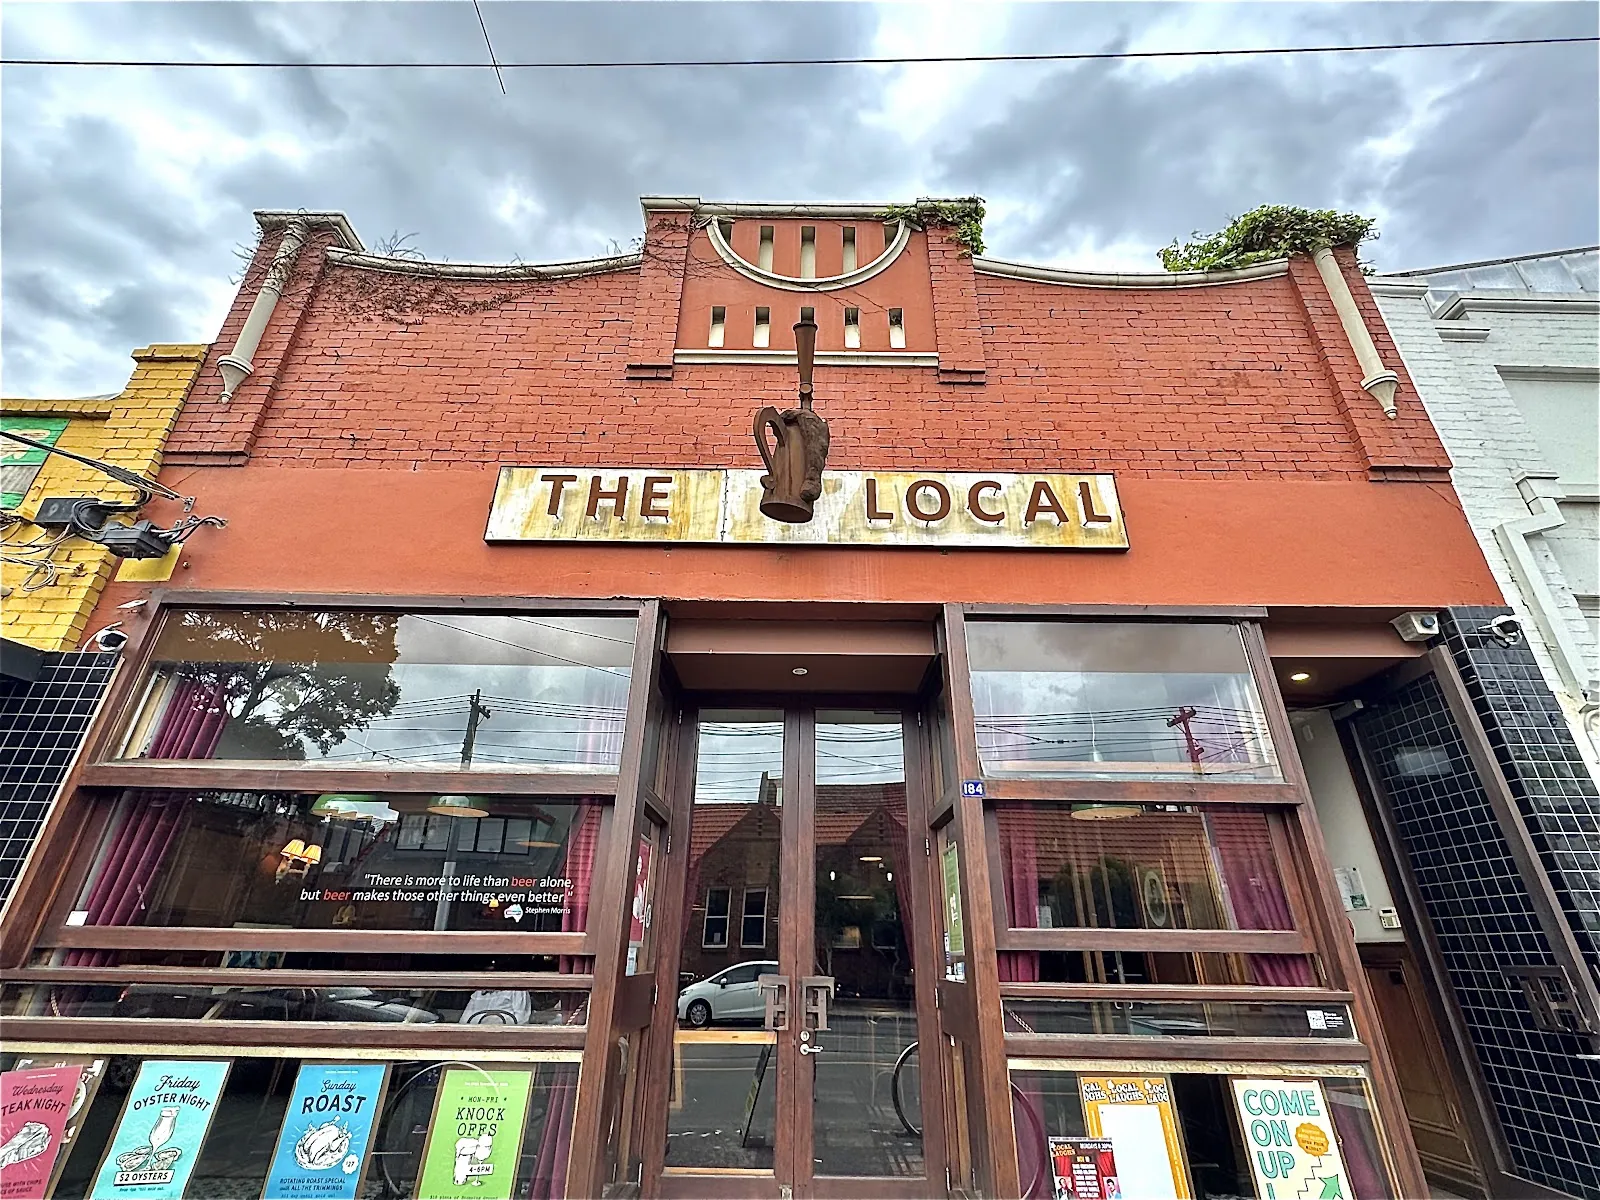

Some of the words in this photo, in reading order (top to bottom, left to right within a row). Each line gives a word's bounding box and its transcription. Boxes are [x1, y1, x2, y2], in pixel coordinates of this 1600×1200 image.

[541, 475, 673, 516] THE
[866, 478, 1112, 522] LOCAL
[963, 783, 983, 795] 184
[364, 873, 402, 886] "There
[404, 875, 413, 886] is
[415, 877, 446, 886] more
[448, 876, 460, 886] to
[463, 875, 480, 887] life
[483, 875, 509, 887] than
[511, 876, 537, 887] beer
[540, 876, 575, 889] alone,
[300, 889, 321, 900] but
[323, 889, 351, 900] beer
[352, 889, 390, 901] makes
[392, 889, 425, 901] those
[427, 889, 459, 901] other
[461, 890, 495, 904] things
[498, 892, 525, 902] even
[528, 891, 573, 903] better."
[525, 907, 550, 915] Stephen
[12, 1083, 64, 1097] Wednesday
[154, 1075, 200, 1092] Friday
[321, 1080, 356, 1093] Sunday
[1084, 1082, 1101, 1092] CAL
[1111, 1083, 1139, 1094] LOCAL
[134, 1093, 177, 1110] OYSTER
[179, 1093, 210, 1111] NIGHT
[302, 1094, 367, 1114] ROAST
[1109, 1091, 1144, 1103] LAUGHS
[1243, 1089, 1320, 1116] COME
[1, 1099, 33, 1117] TEAK
[33, 1098, 67, 1114] NIGHT
[456, 1107, 506, 1120] KNOCK
[457, 1122, 497, 1137] OFFS
[1251, 1119, 1292, 1147] ON
[1257, 1151, 1295, 1179] UP
[132, 1172, 168, 1181] OYSTERS
